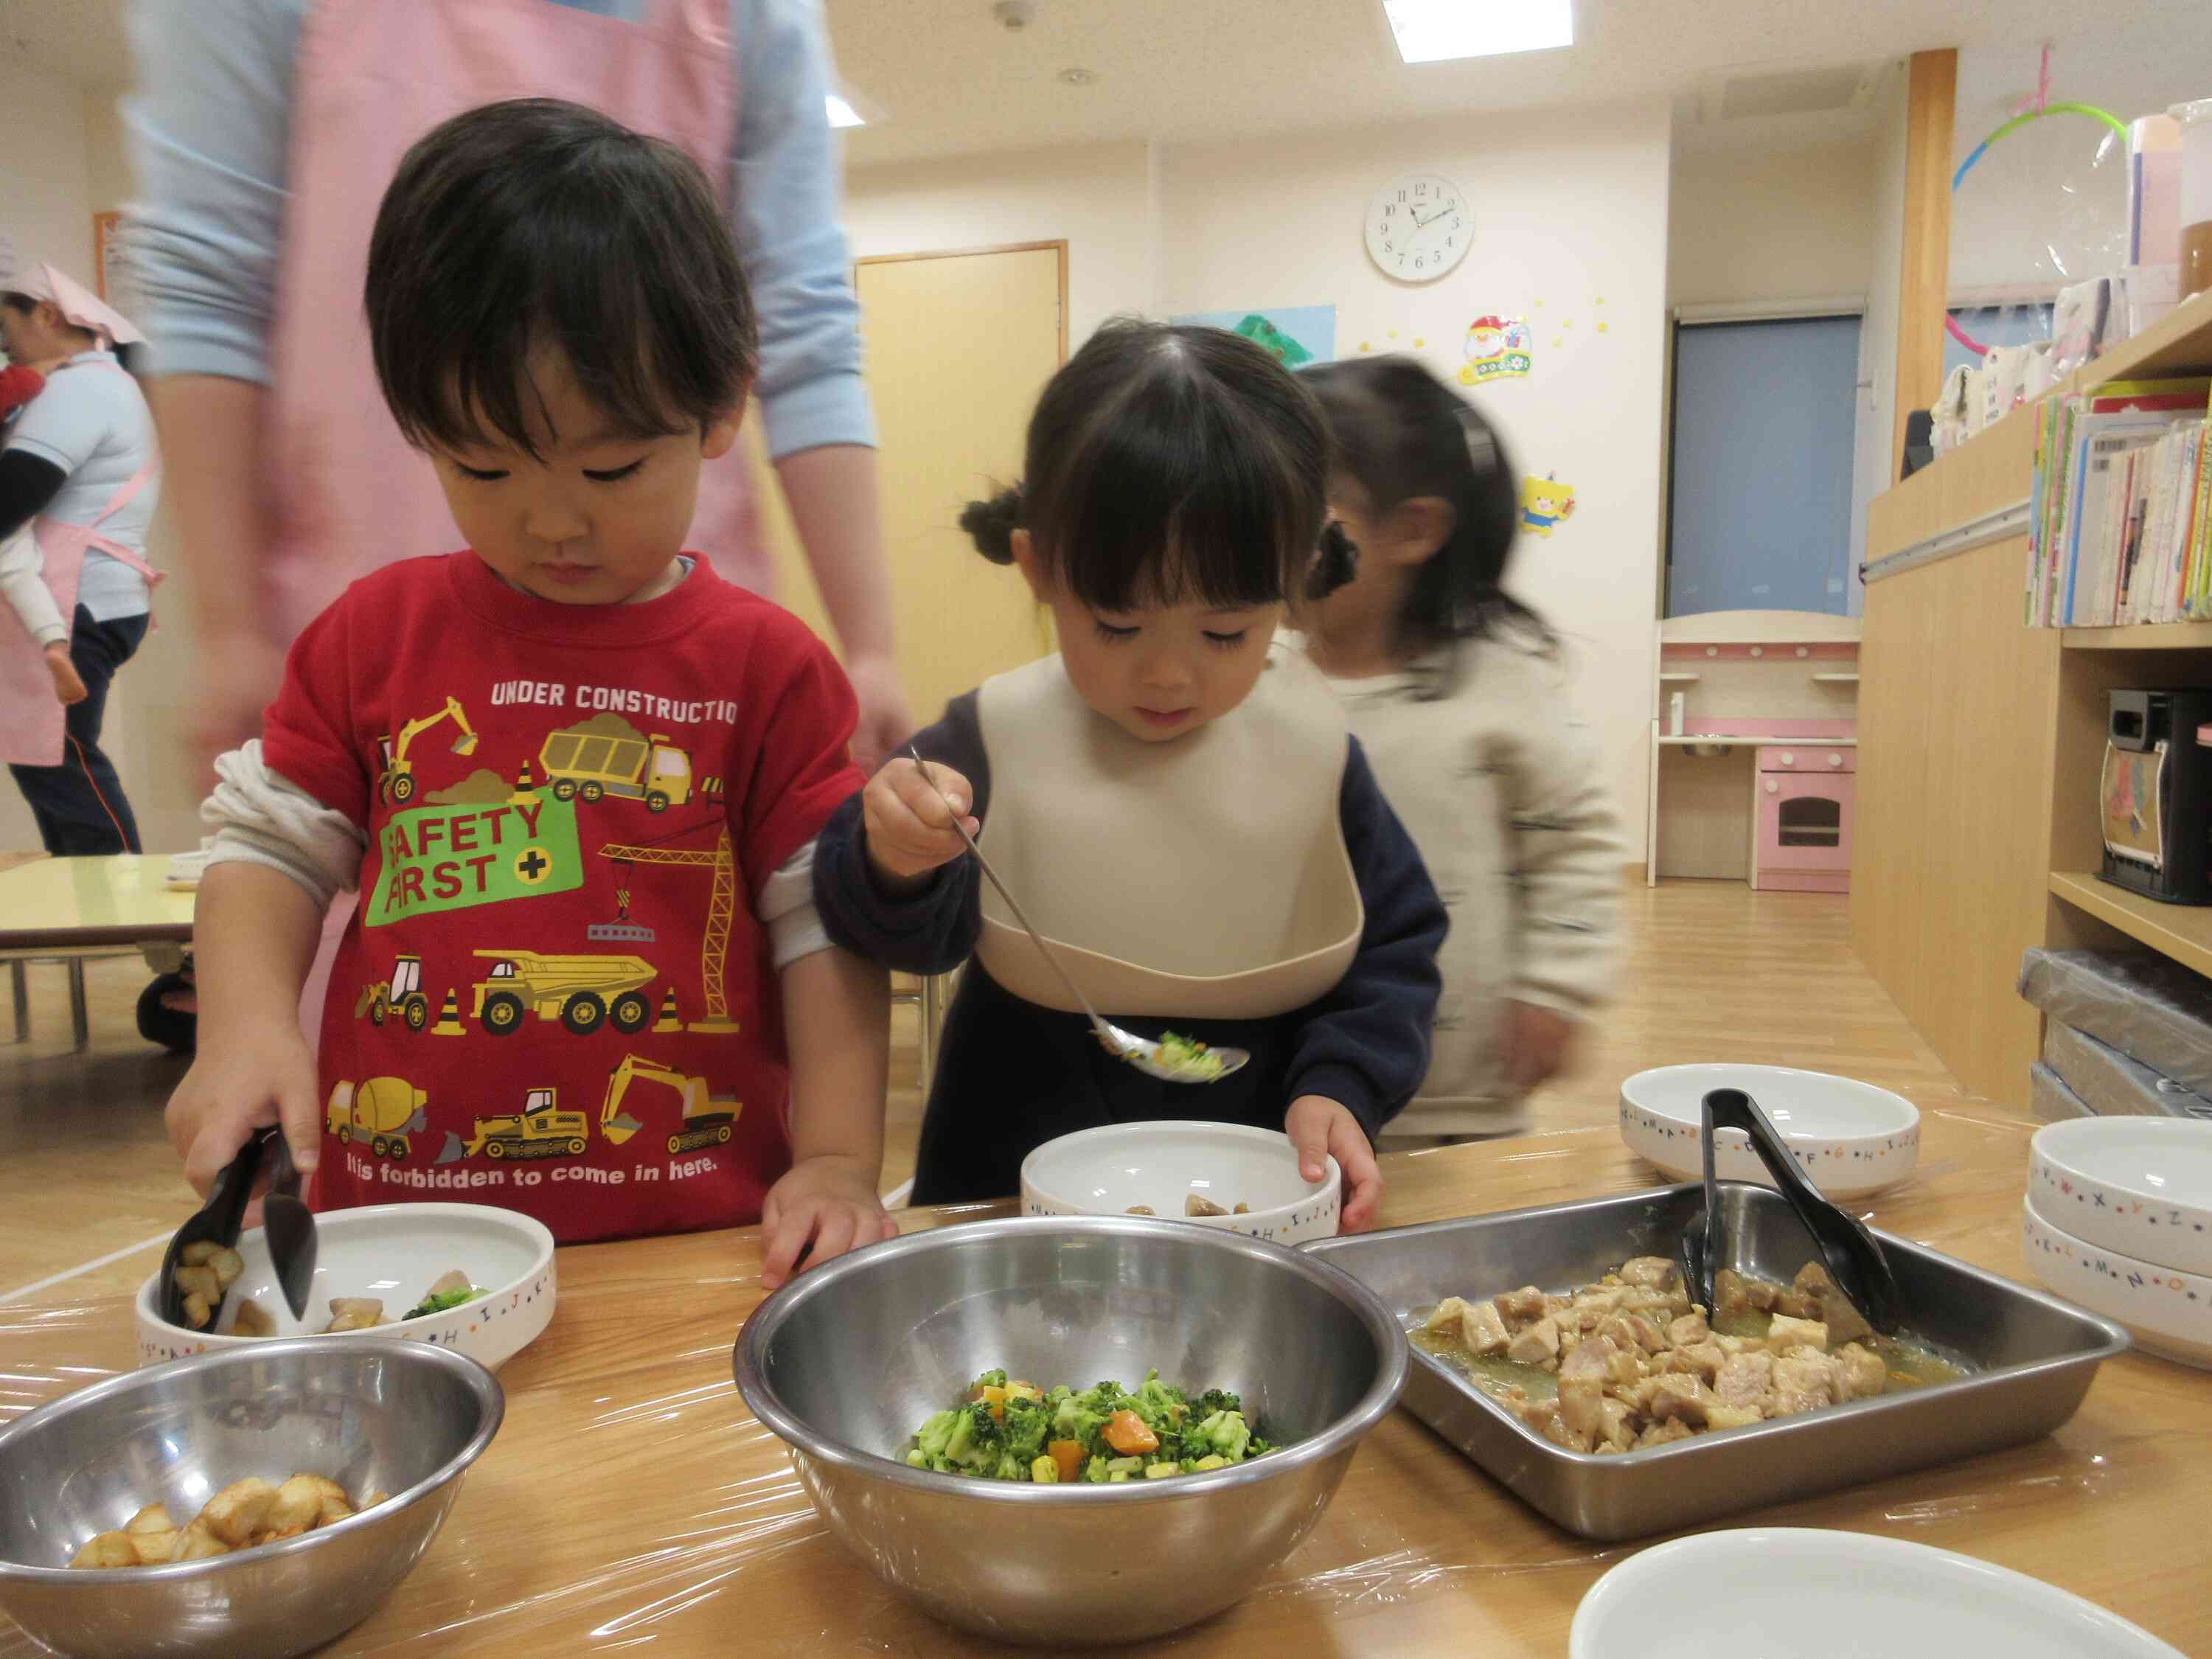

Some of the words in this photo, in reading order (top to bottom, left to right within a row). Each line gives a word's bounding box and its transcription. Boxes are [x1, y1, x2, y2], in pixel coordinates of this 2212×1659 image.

[1414, 182, 1427, 195] 12
[1397, 189, 1406, 203] 11
[1385, 204, 1396, 217] 10
[1380, 223, 1388, 235] 9
[1450, 217, 1460, 230] 3
[1384, 240, 1393, 253] 8
[1397, 253, 1405, 265] 7
[1415, 256, 1424, 268] 6
[1433, 250, 1441, 263] 5
[490, 680, 566, 706] UNDER
[1806, 1152, 1815, 1165] F
[379, 1162, 505, 1189] forbidden
[512, 1167, 542, 1186] to
[551, 1166, 626, 1184] come
[634, 1164, 660, 1181] in
[669, 1156, 718, 1181] here.
[2093, 1192, 2107, 1207] X
[2126, 1272, 2144, 1288] N
[2168, 1277, 2184, 1291] O
[443, 1327, 458, 1343] H
[480, 1306, 490, 1322] I
[512, 1293, 520, 1310] J
